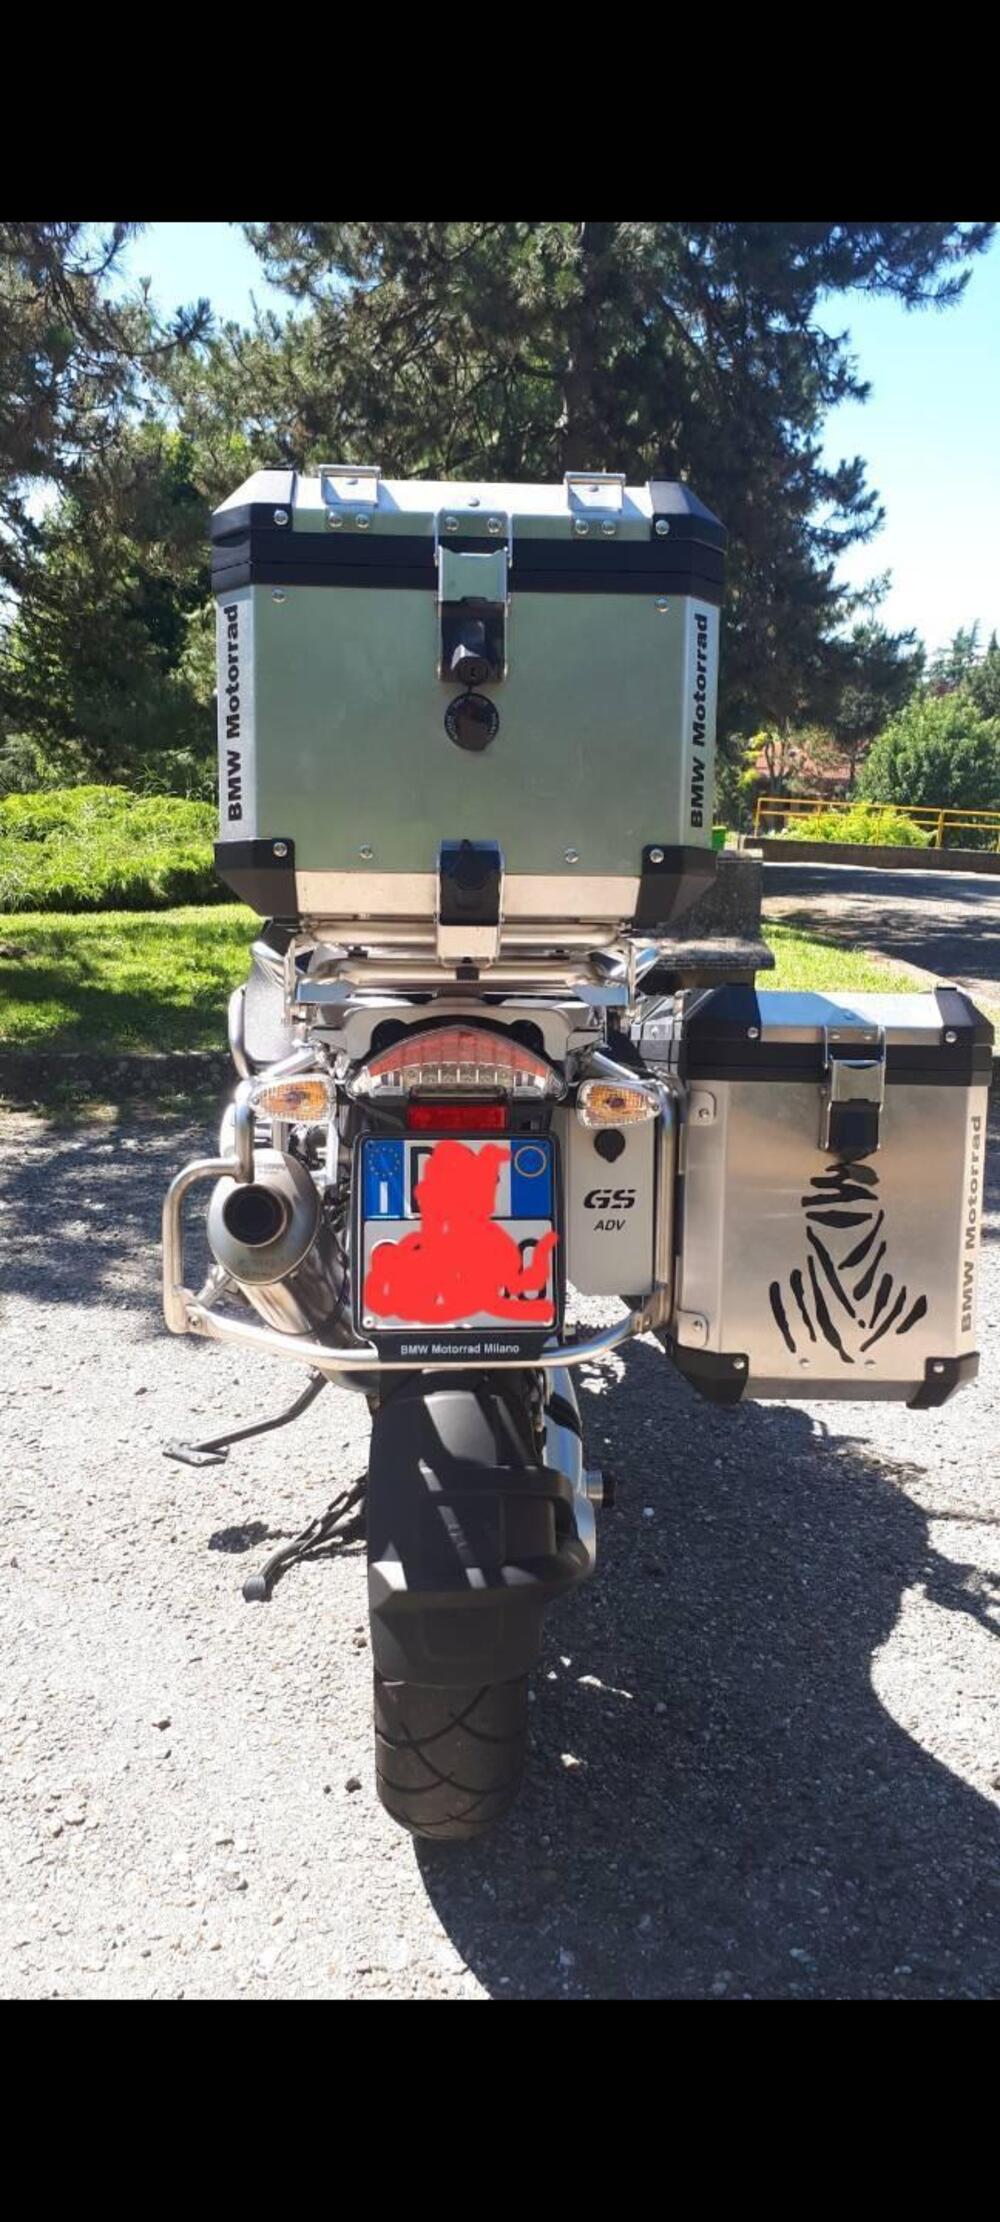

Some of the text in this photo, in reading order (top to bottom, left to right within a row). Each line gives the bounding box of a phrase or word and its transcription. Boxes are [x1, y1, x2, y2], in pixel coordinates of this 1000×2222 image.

[224, 604, 243, 821] BMW Motorrad
[690, 614, 708, 828] BMW Motorrad
[380, 1181, 388, 1213] I
[584, 1189, 636, 1209] GS
[594, 1219, 626, 1231] ADV
[961, 1116, 981, 1332] BMW Motorrad
[400, 1343, 519, 1355] BMW Motorrad Milano
